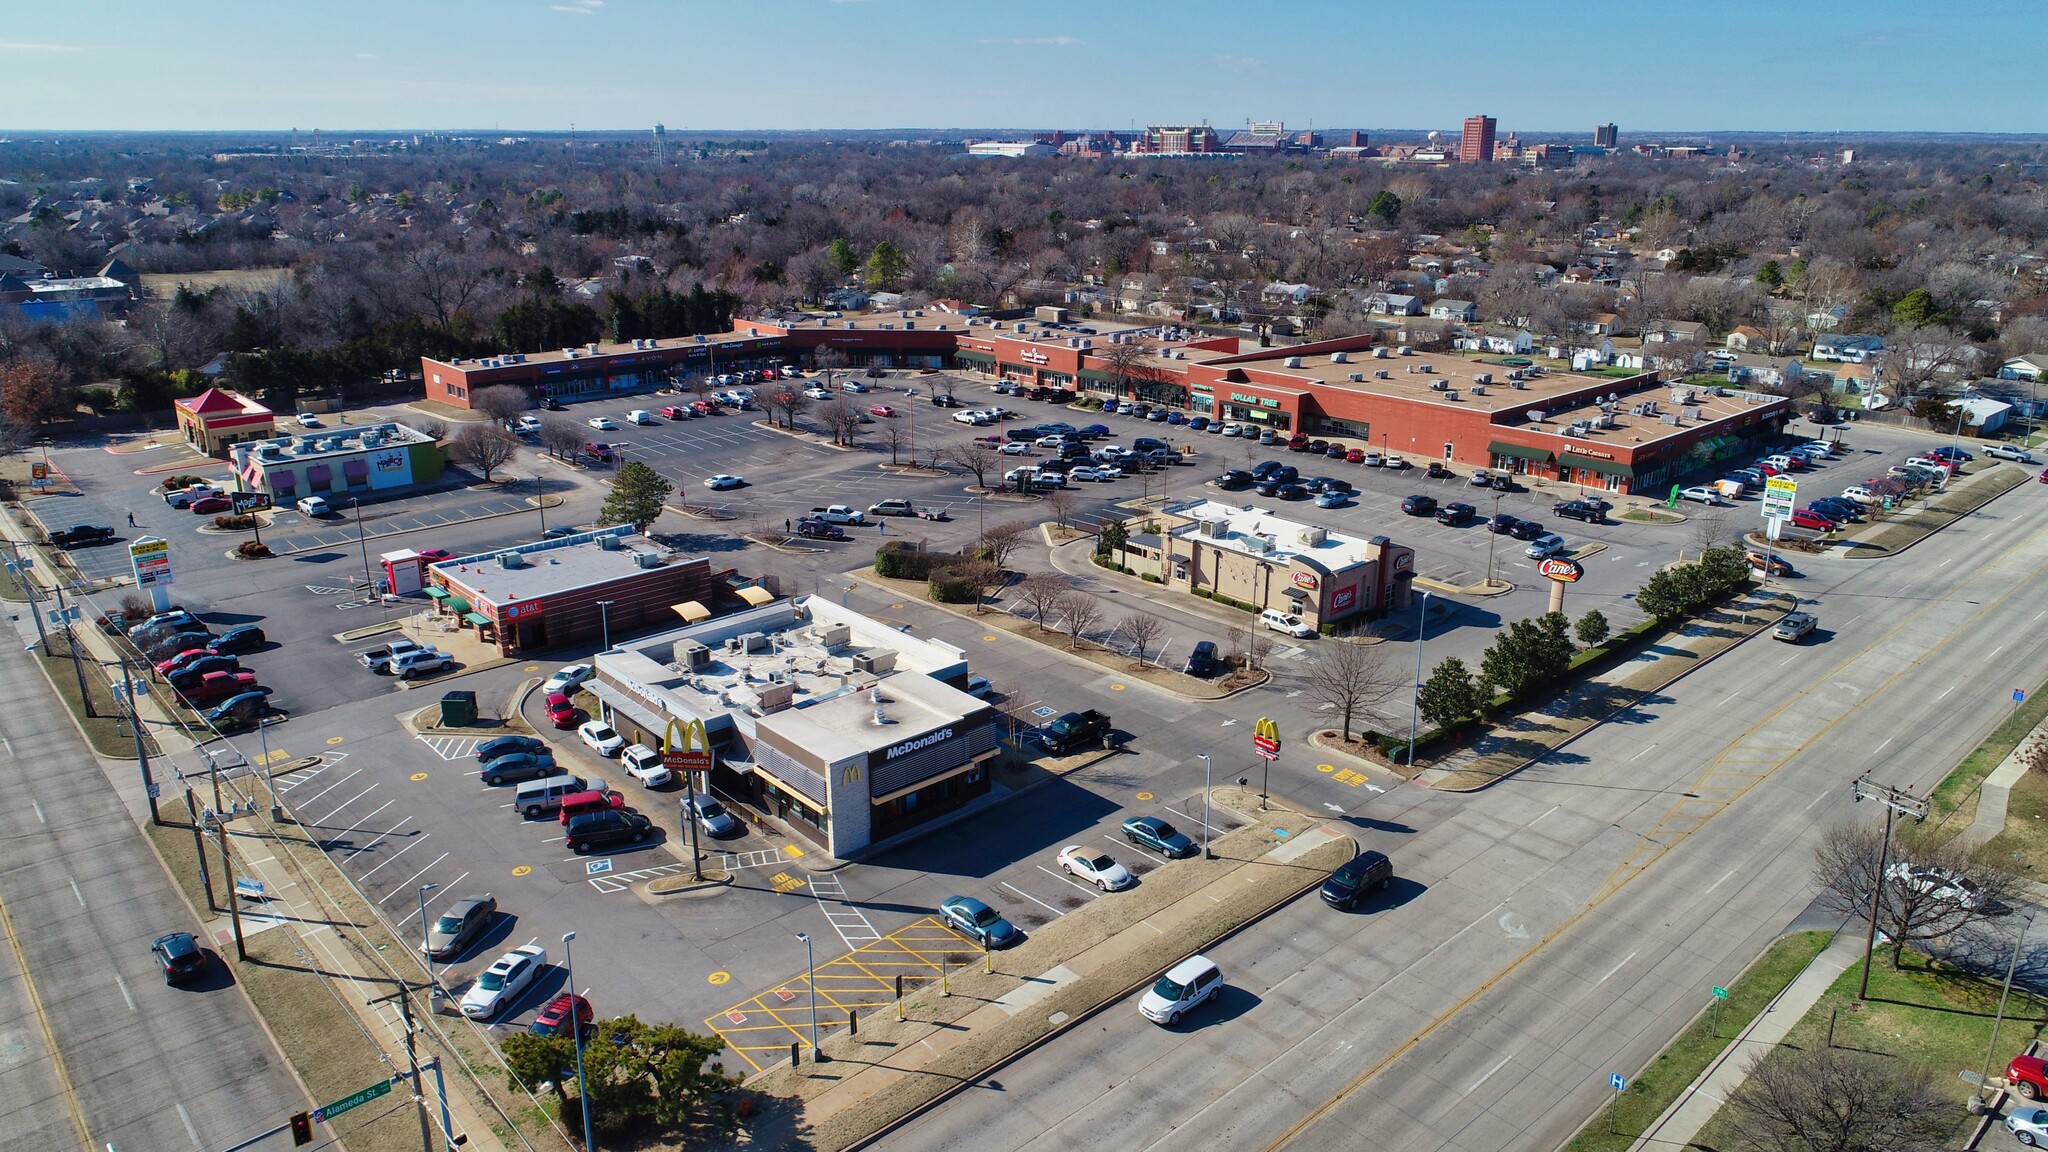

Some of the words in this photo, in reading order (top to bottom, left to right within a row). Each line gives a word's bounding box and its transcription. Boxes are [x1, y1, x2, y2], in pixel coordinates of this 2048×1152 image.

[1230, 392, 1257, 404] DOLLAR
[1260, 397, 1278, 407] TREE
[1572, 446, 1588, 455] Little
[1588, 449, 1611, 458] Caesars
[34, 469, 43, 478] 5
[1540, 558, 1578, 575] Cane's
[1292, 571, 1316, 584] Cane's
[1333, 590, 1352, 608] Cane's
[521, 602, 539, 613] at&t
[886, 728, 953, 760] McDonald's
[1255, 738, 1275, 750] McDonald's
[663, 756, 710, 765] McDonald's
[1611, 1073, 1624, 1089] H
[326, 1094, 365, 1117] Alameda
[366, 1088, 379, 1099] St.
